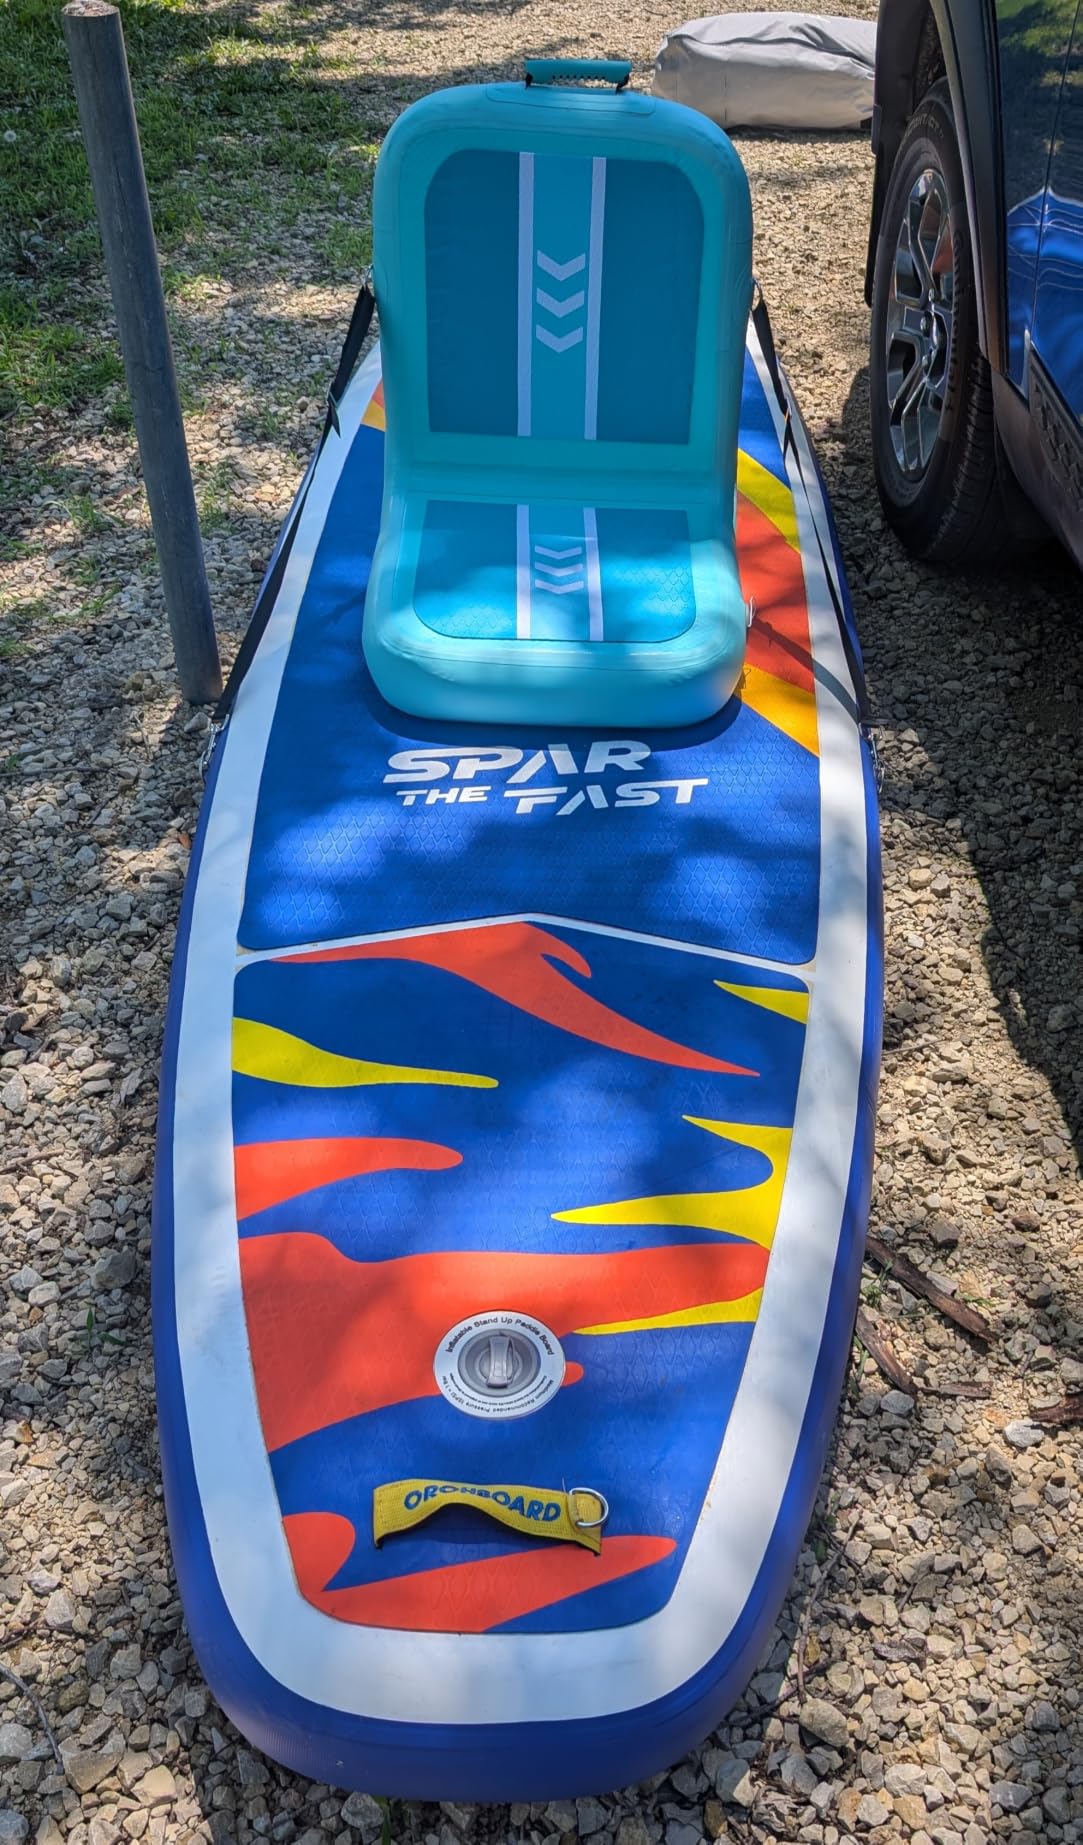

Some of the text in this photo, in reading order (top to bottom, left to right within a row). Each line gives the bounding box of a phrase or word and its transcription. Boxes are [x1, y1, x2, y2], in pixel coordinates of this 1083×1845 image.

[383, 740, 651, 784] SPAR
[396, 778, 709, 816] THE FAST
[446, 1316, 555, 1355] Inflatable Stand Up Paddle Board
[466, 1402, 490, 1413] Pressure
